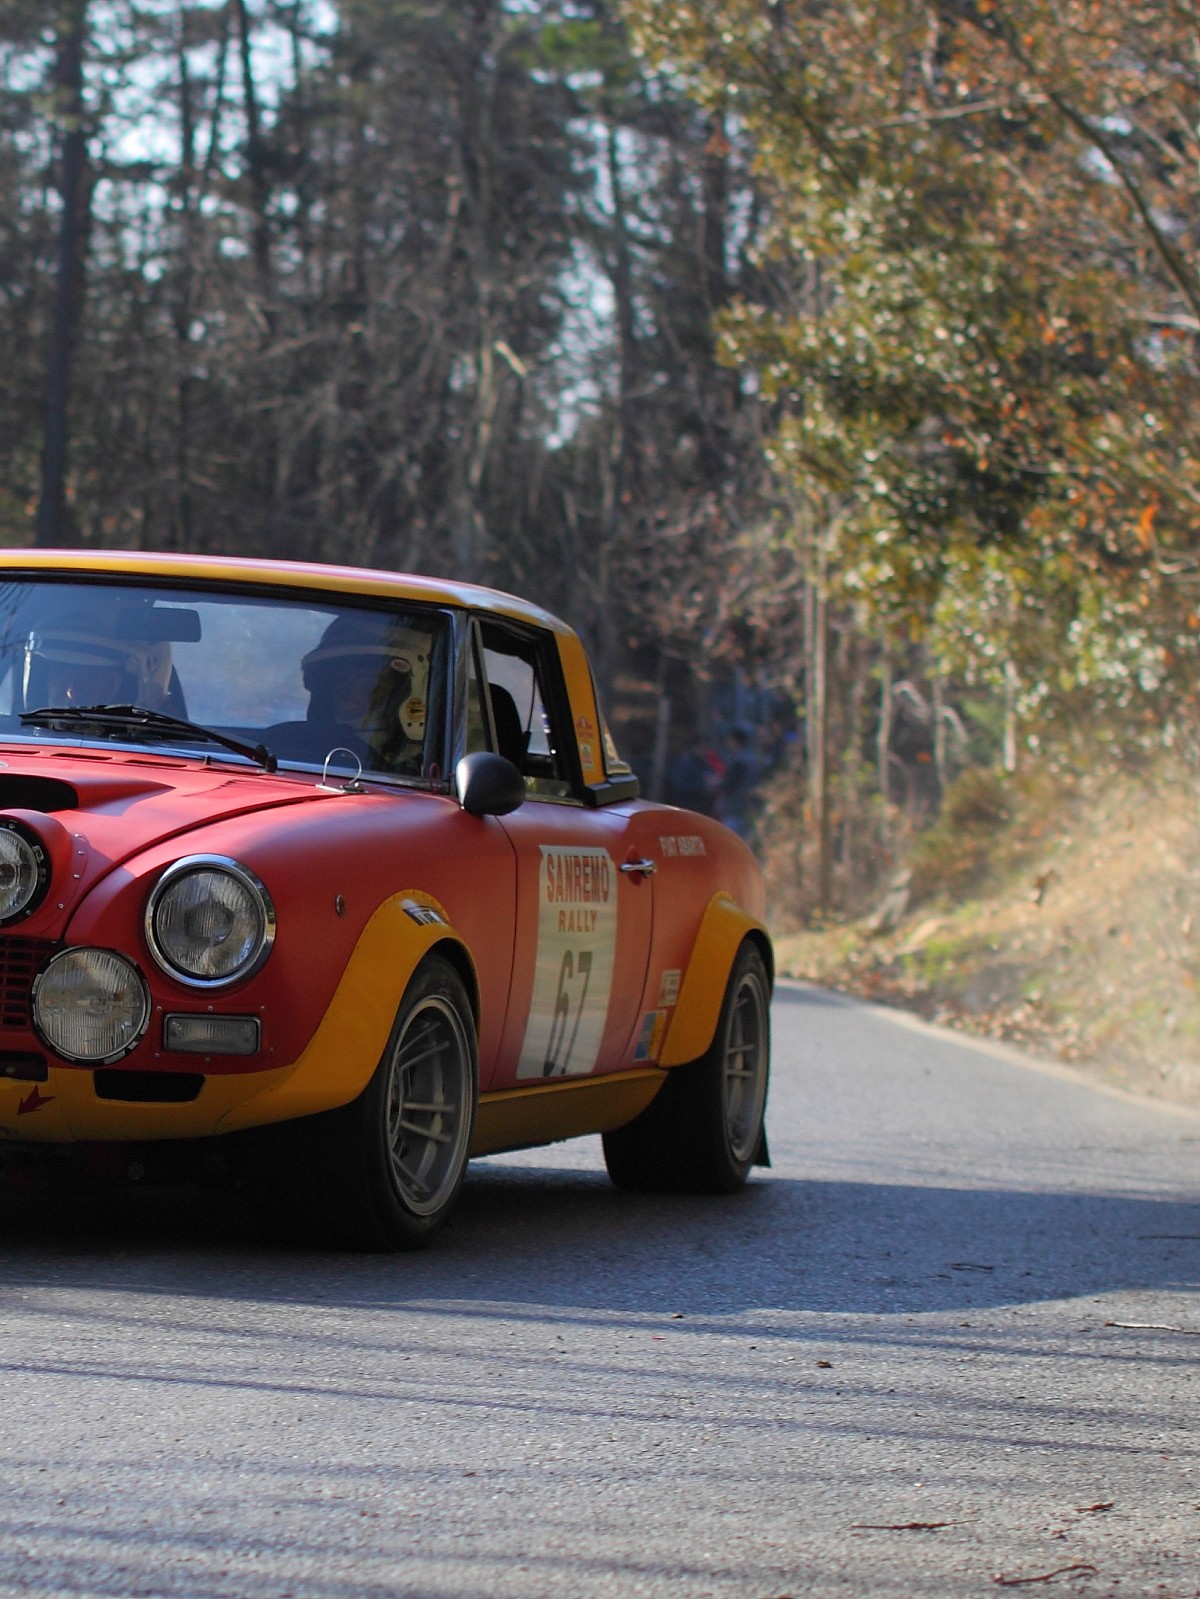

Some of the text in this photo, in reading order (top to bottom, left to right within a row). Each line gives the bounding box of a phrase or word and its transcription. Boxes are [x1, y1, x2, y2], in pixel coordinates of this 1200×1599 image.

[546, 853, 610, 903] SANREMO
[558, 909, 598, 932] RALLY
[543, 949, 593, 1077] 67
